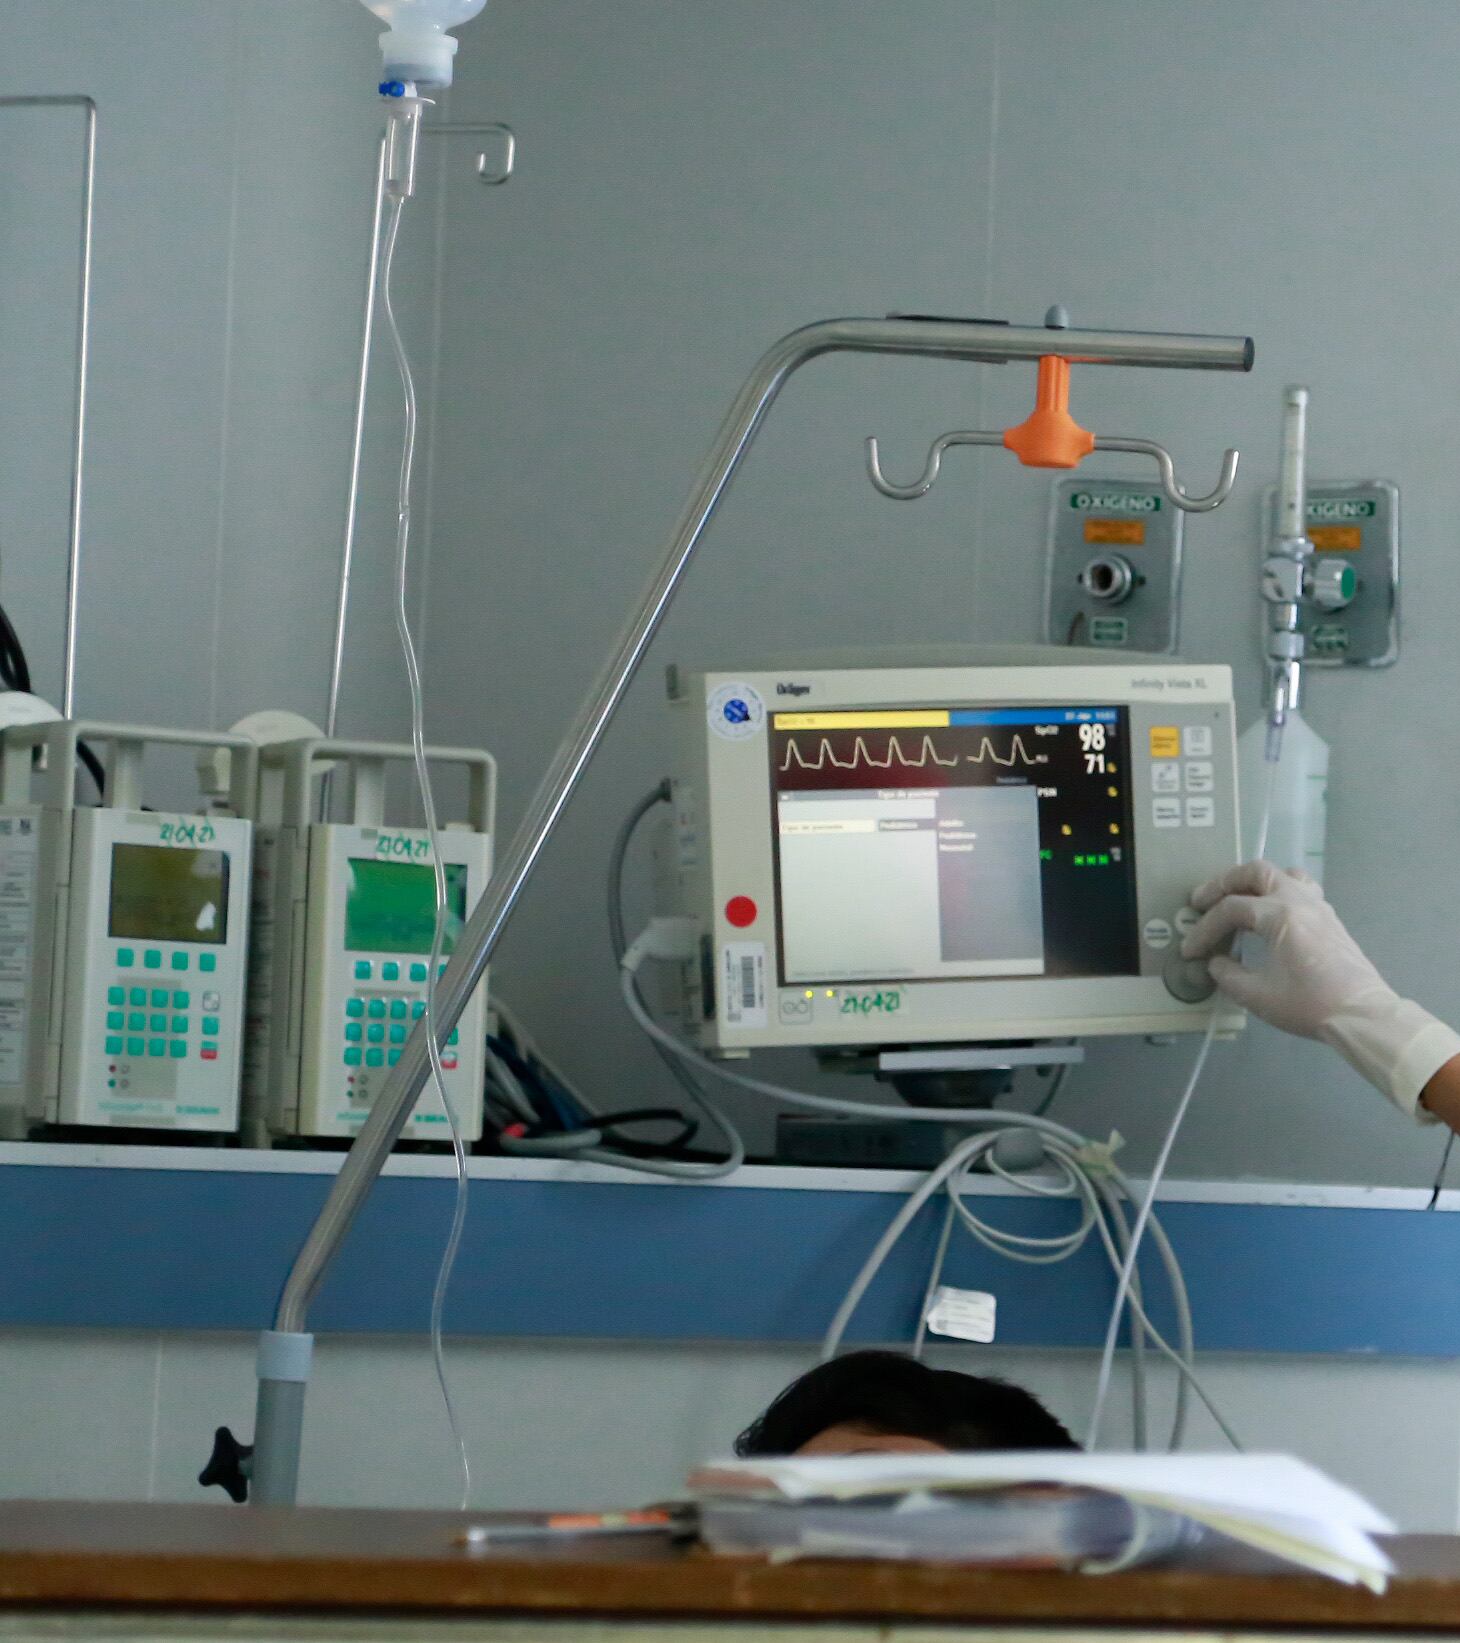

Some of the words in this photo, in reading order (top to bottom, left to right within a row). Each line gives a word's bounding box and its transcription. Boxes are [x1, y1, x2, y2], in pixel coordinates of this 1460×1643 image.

[1076, 494, 1156, 512] OXIGENO
[1304, 501, 1369, 517] XIGENO
[1078, 723, 1106, 751] 98
[1083, 753, 1105, 774] 71
